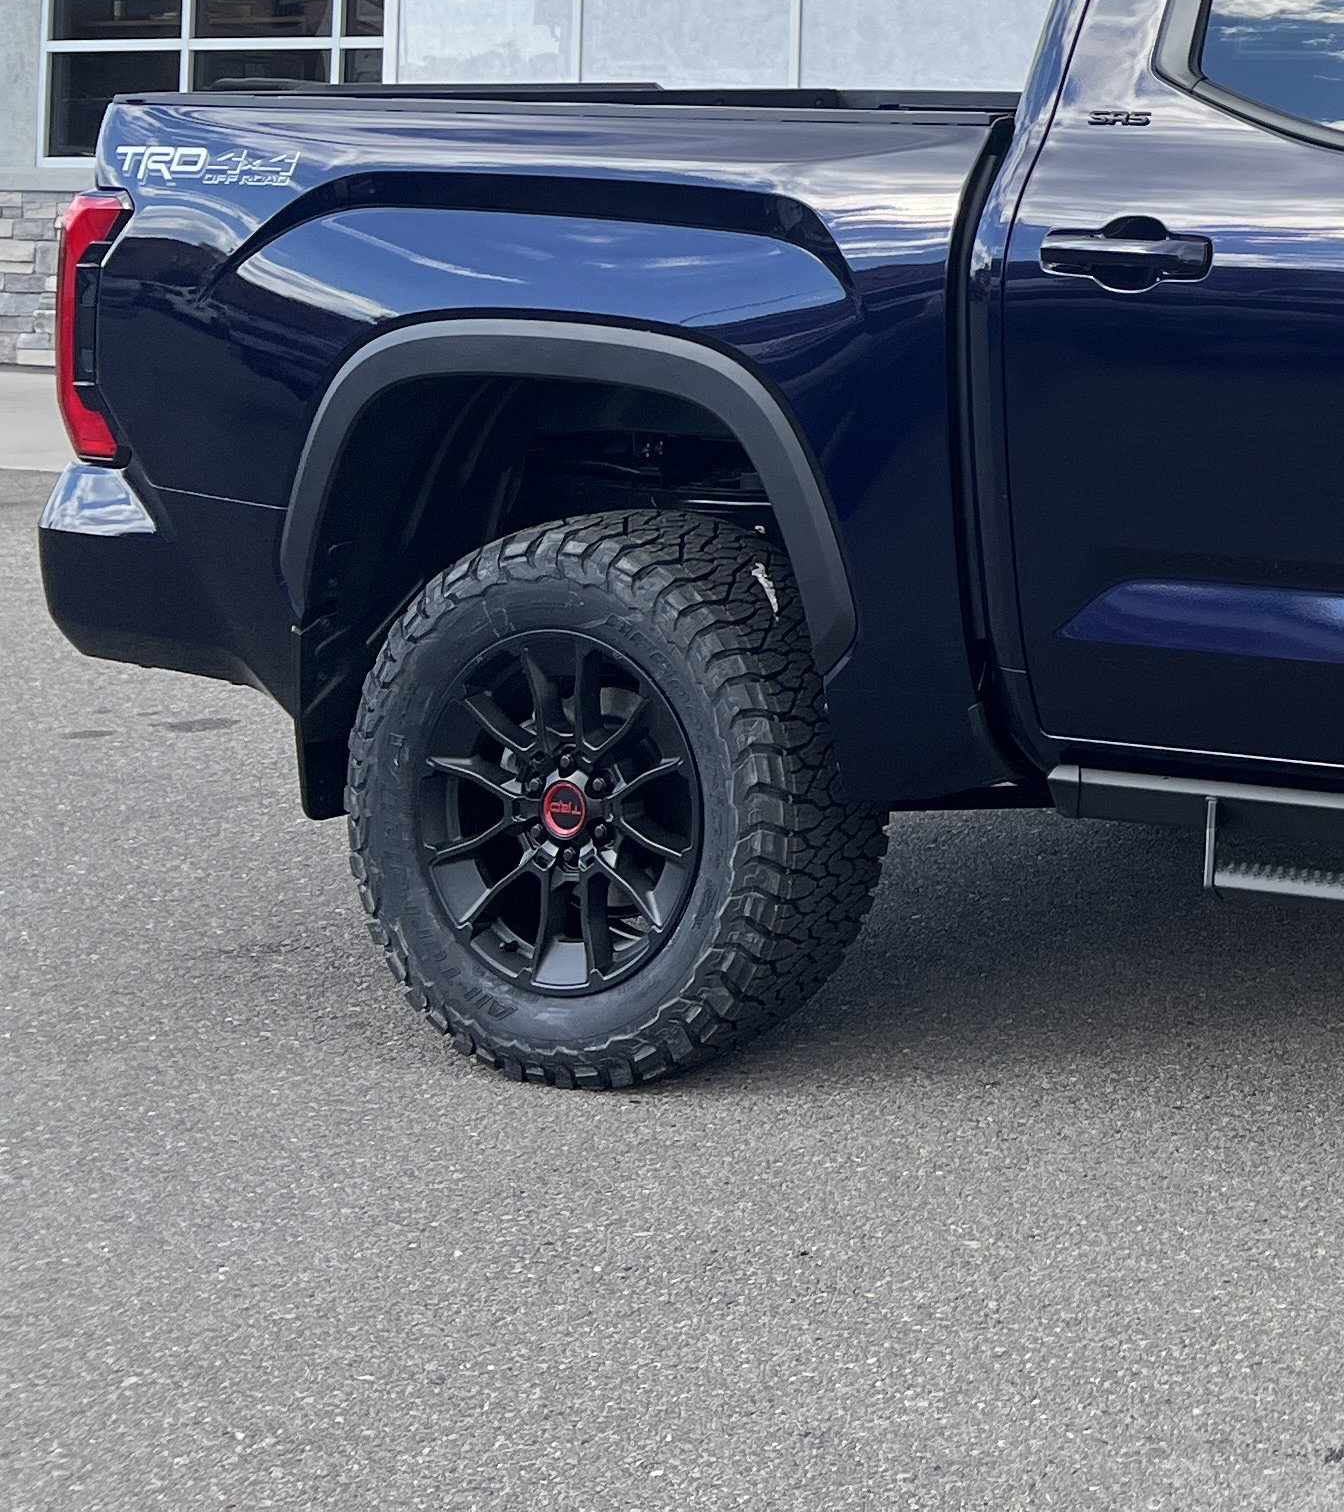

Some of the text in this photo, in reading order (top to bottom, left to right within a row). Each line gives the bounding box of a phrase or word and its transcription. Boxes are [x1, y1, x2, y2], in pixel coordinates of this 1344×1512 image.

[116, 145, 210, 186] TRD
[202, 174, 291, 187] OFF ROAD
